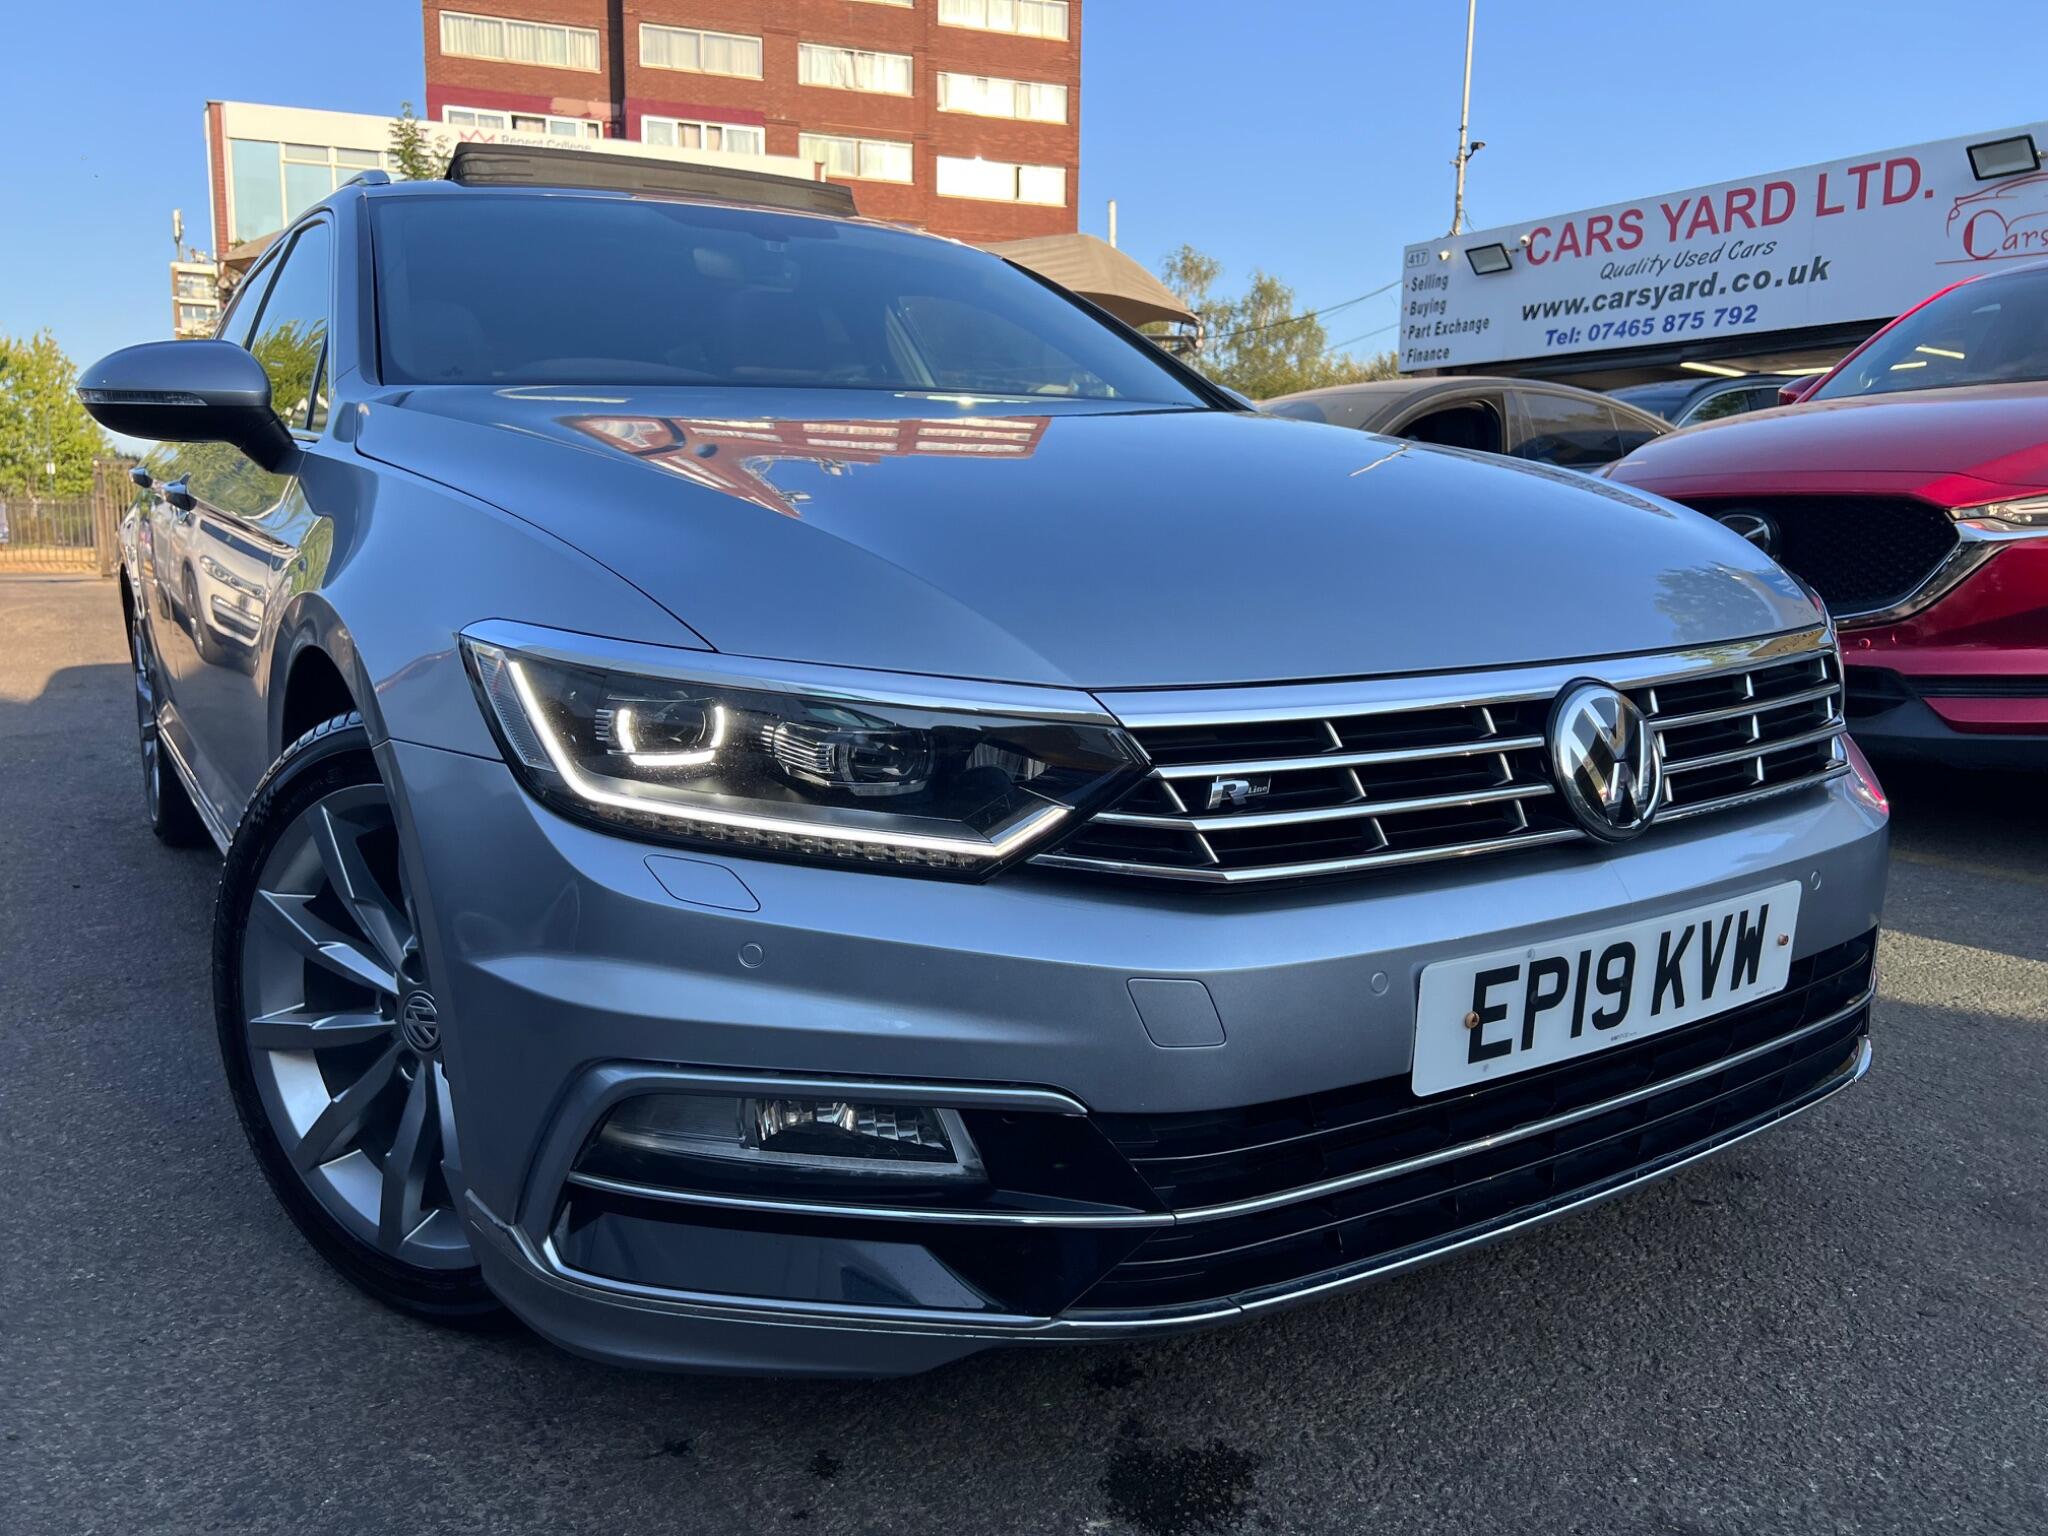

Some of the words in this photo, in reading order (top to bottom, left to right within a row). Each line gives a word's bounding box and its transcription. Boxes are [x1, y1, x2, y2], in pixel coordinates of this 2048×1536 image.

[1526, 208, 1644, 266] CARS
[1660, 180, 1796, 242] YARD
[1816, 157, 1934, 217] LTD.
[1408, 252, 1427, 264] 417
[1600, 253, 1672, 280] Quality
[1673, 242, 1726, 270] Used
[1728, 240, 1778, 266] Cars
[1411, 274, 1449, 292] Selling
[1522, 255, 1832, 322] www.carsyard.co.uk
[1409, 298, 1447, 318] Buying
[1408, 324, 1431, 340] Part
[1434, 317, 1490, 335] Exchange
[1545, 326, 1581, 347] Tel:
[1587, 316, 1656, 342] 07465
[1661, 309, 1706, 333] 875
[1713, 303, 1759, 327] 792
[1407, 347, 1450, 364] Finance
[1467, 941, 1637, 1065] EP19
[1649, 904, 1770, 1016] KVW
